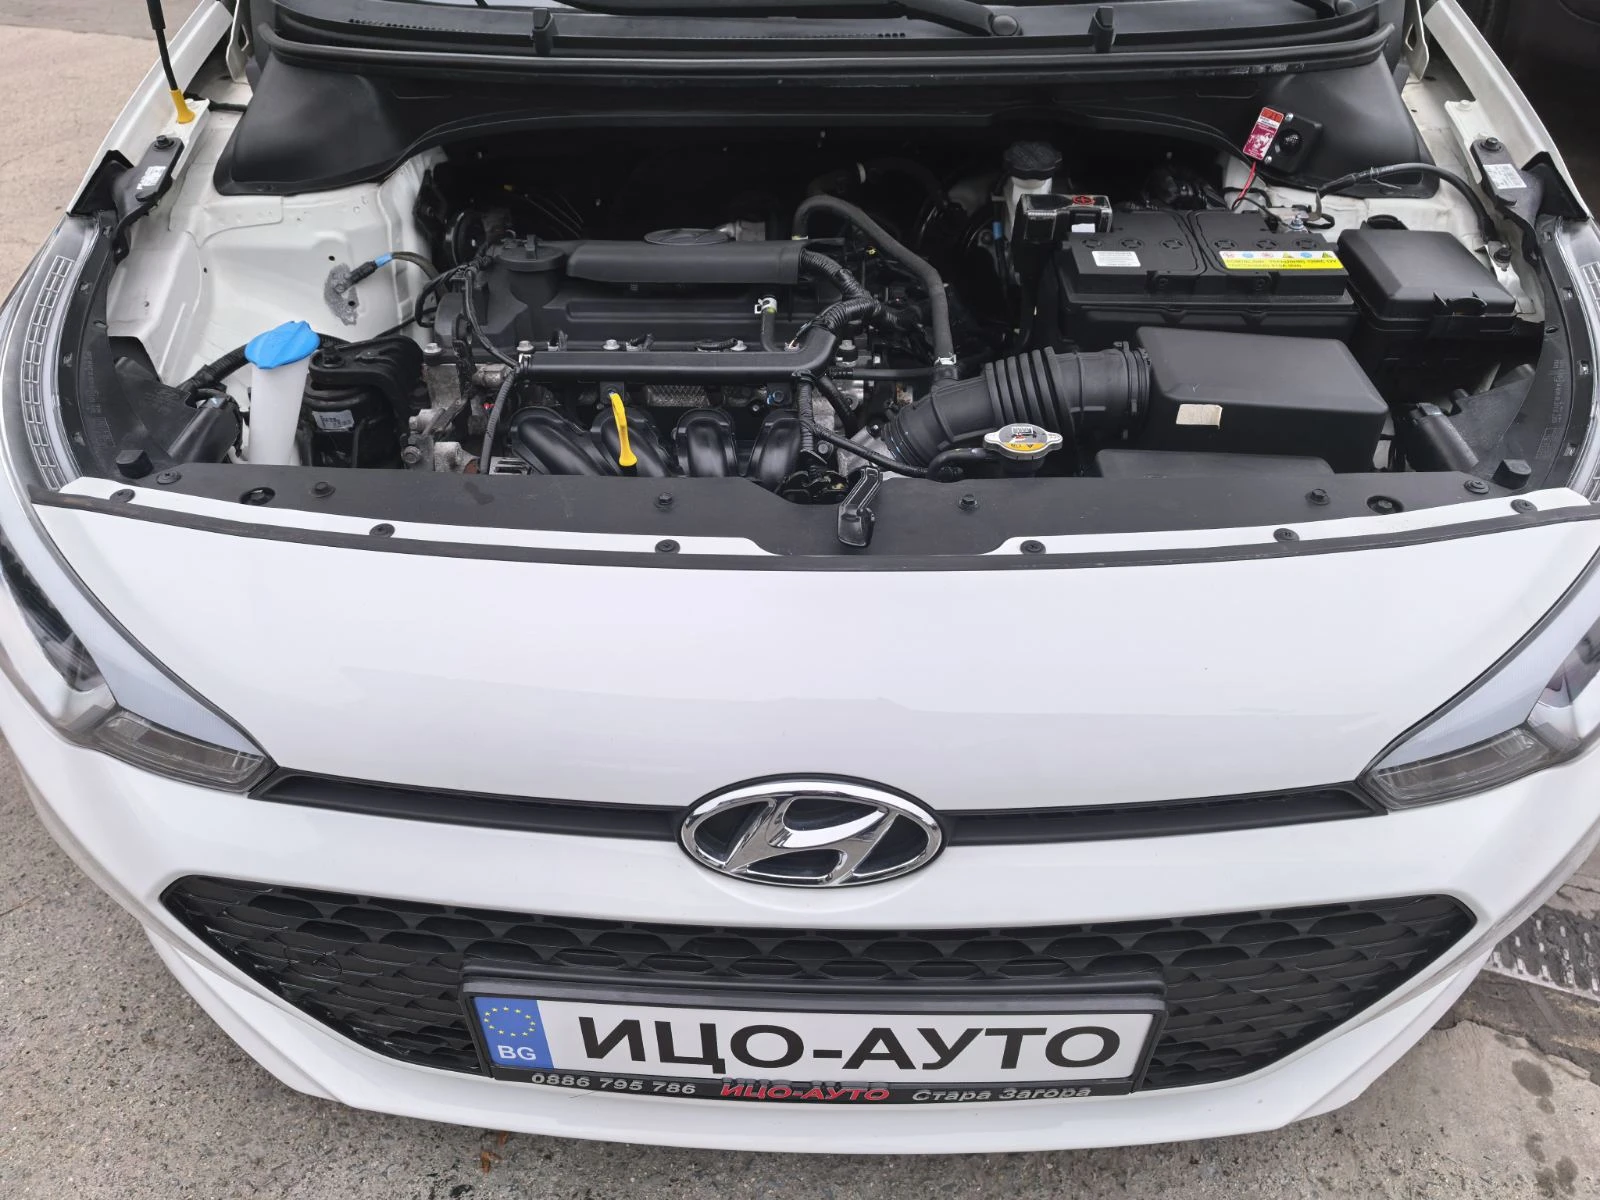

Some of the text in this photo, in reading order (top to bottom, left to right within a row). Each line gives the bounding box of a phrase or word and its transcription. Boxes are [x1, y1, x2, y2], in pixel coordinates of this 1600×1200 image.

[497, 1045, 537, 1061] BG
[578, 1017, 1121, 1074] ИЦО-АУТО
[531, 1073, 1092, 1102] 0886 795 786 ИЦО-АУТО Стара Загора
